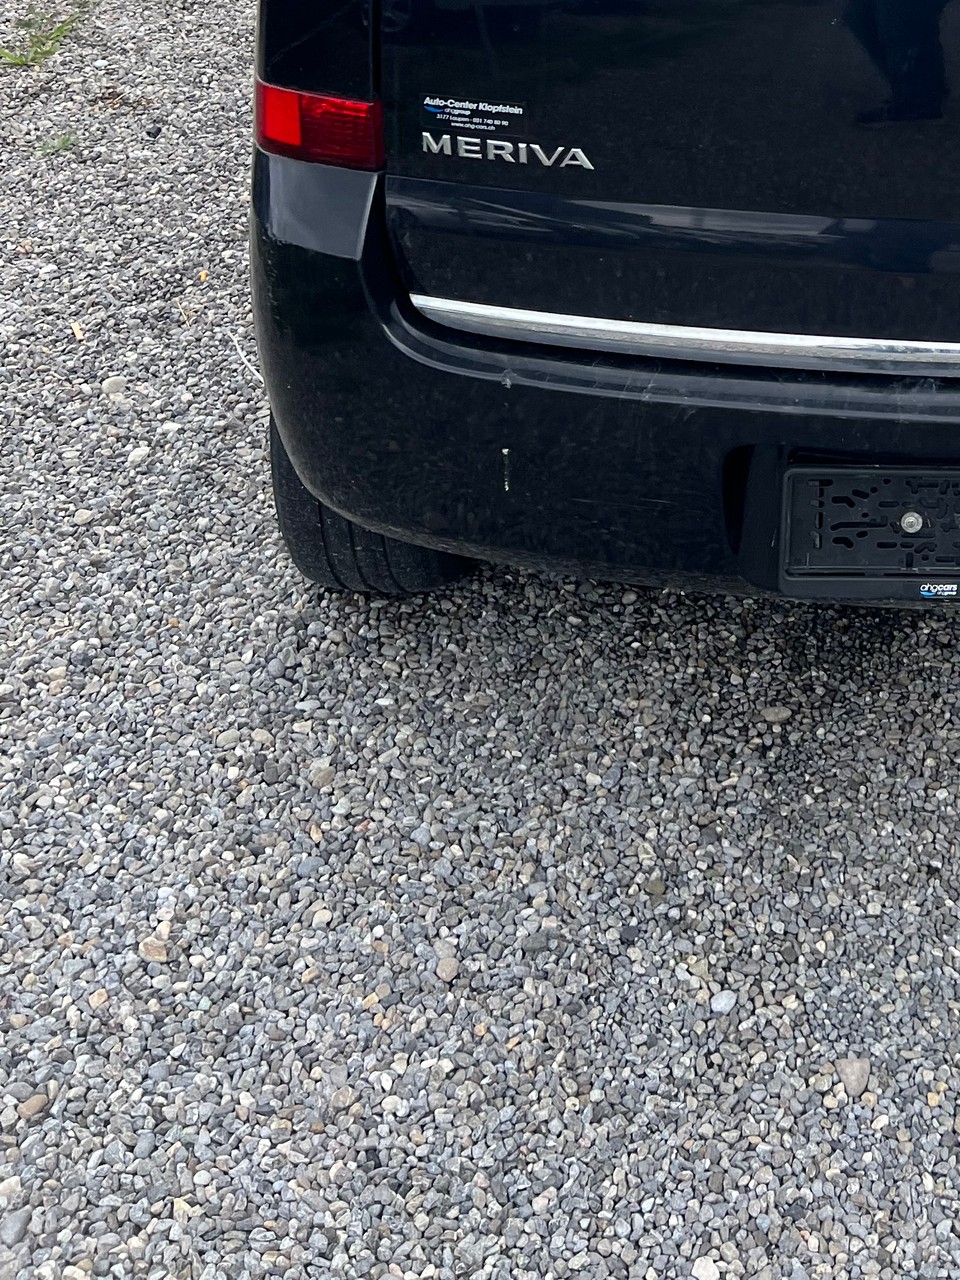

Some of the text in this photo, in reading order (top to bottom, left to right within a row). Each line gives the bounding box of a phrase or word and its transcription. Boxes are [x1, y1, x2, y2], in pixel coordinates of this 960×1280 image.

[423, 96, 523, 115] Auto-Center Klopfstein
[421, 131, 595, 171] MERIVA
